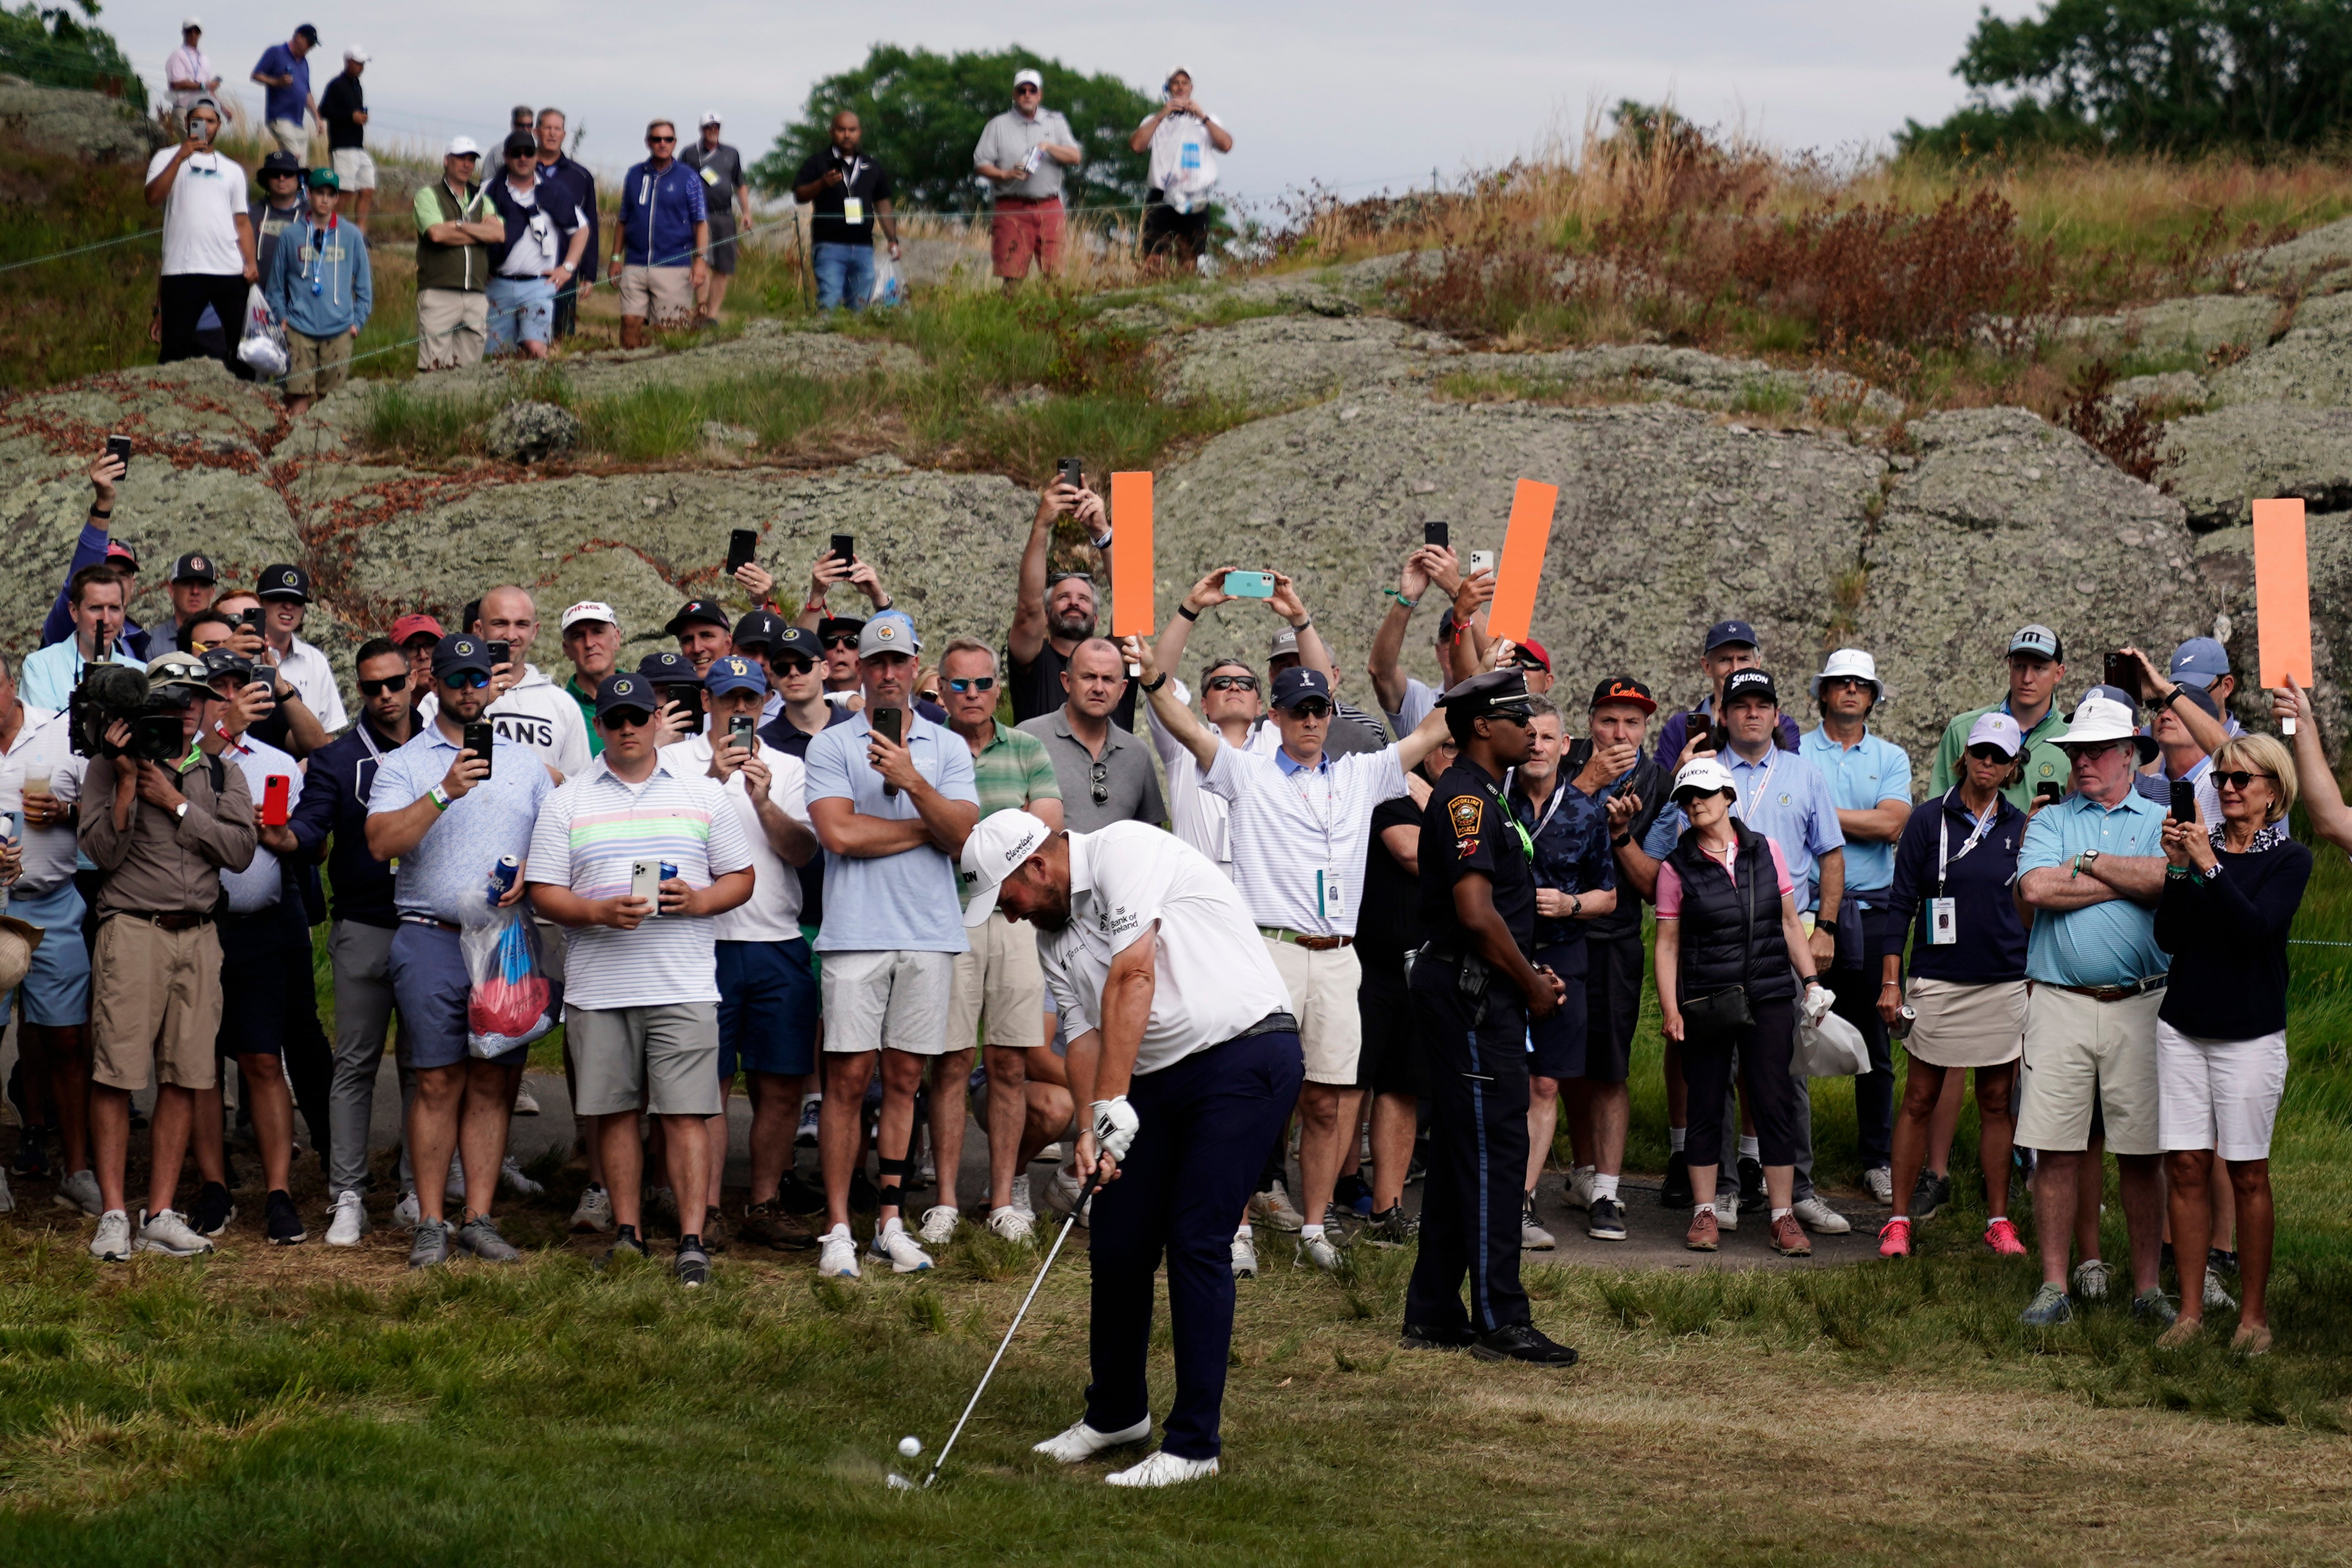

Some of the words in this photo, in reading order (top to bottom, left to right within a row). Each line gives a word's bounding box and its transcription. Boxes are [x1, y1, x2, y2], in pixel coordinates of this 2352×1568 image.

[568, 604, 600, 618] PING
[1731, 672, 1769, 690] SRIXON
[488, 713, 552, 747] ANS
[1451, 798, 1480, 809] BROOKLINE
[1458, 826, 1475, 834] POLICE
[1005, 830, 1034, 861] Cleveland
[1017, 842, 1033, 859] GOLF
[1110, 916, 1128, 929] Bank
[1129, 912, 1137, 921] of
[1112, 921, 1139, 936] Ireland
